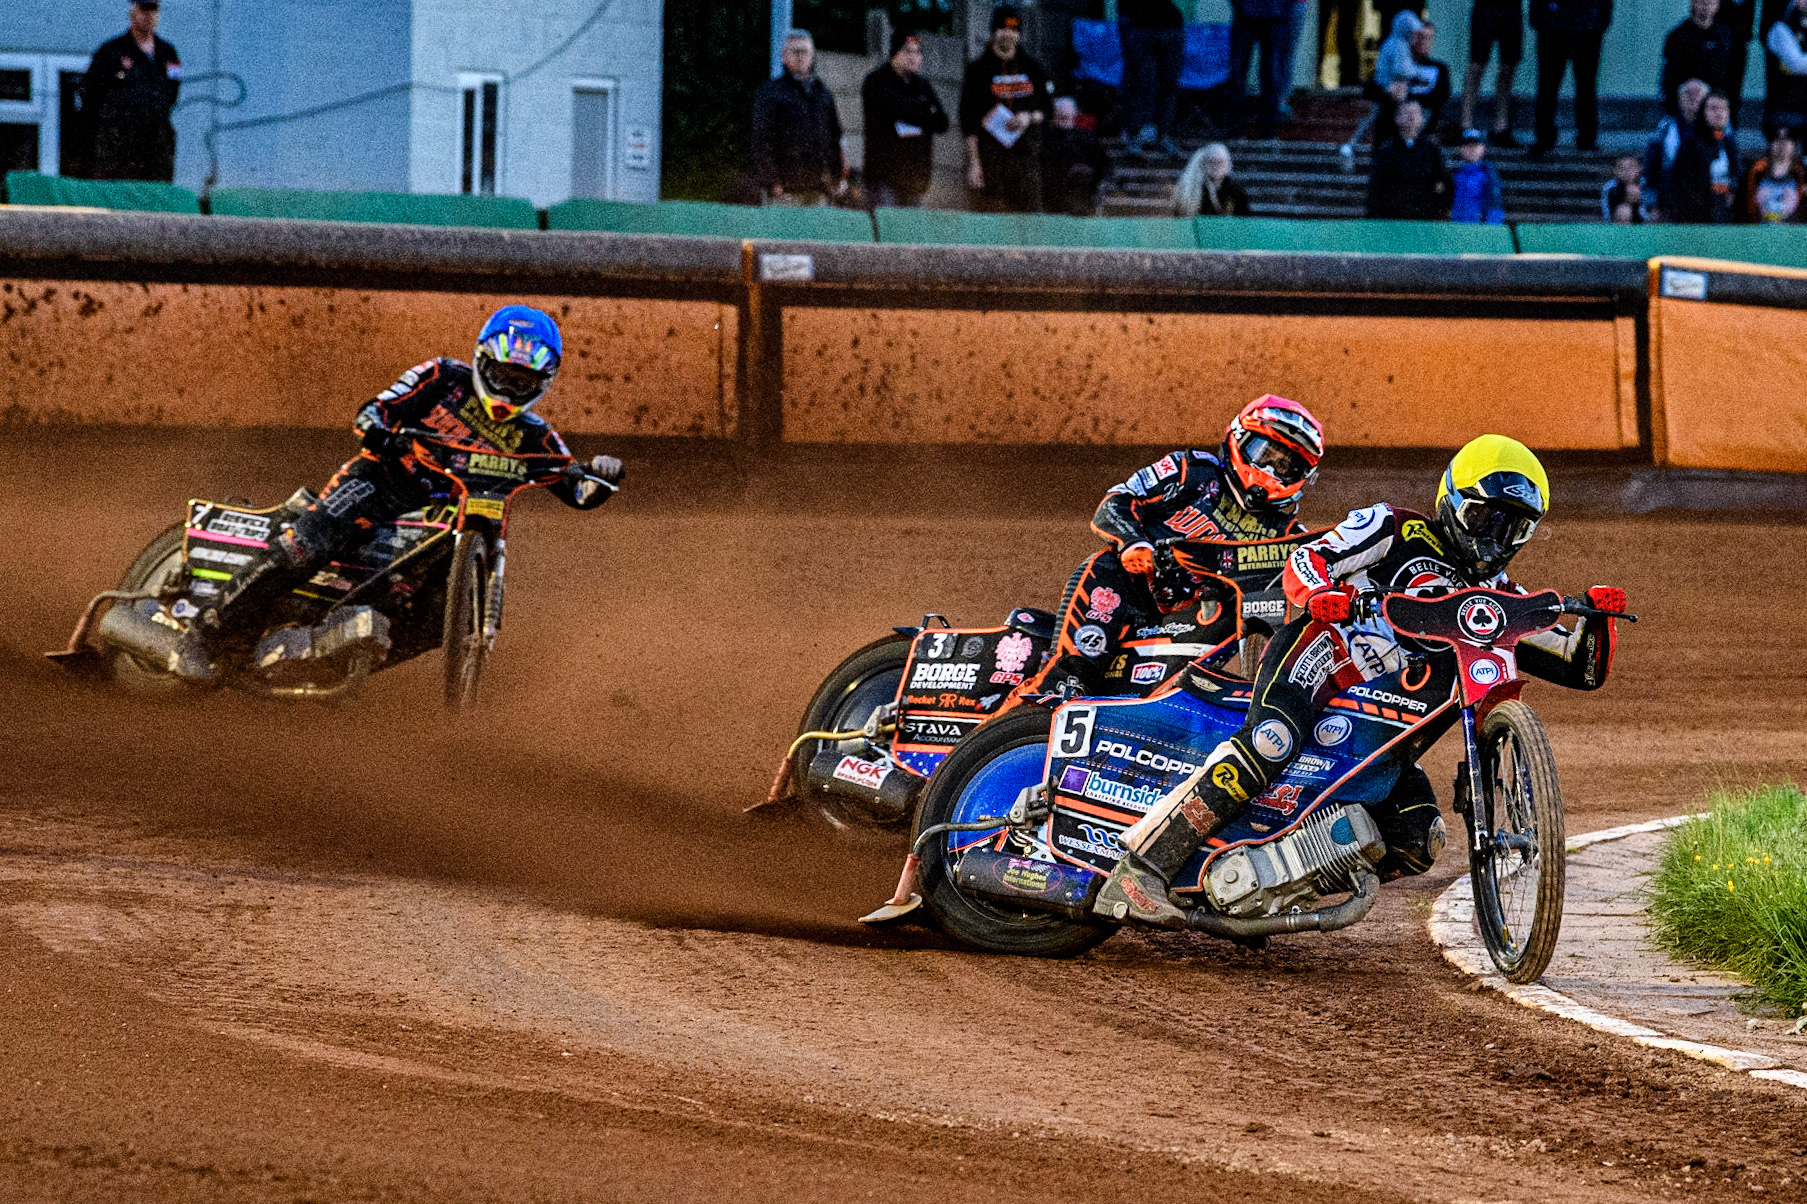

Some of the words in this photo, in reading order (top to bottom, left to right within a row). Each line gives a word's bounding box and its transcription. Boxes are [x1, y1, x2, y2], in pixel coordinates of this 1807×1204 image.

[192, 504, 209, 524] 7
[1237, 543, 1299, 563] PARRYS
[1408, 561, 1440, 575] BELLE
[1242, 600, 1286, 614] BORGE
[927, 633, 948, 658] 3
[912, 663, 981, 682] BORGE
[990, 671, 1024, 685] GPS
[1476, 667, 1494, 677] ATPI
[910, 681, 976, 690] DEVELOPMENT
[1347, 686, 1428, 713] POLCOPPER
[905, 722, 962, 736] STAVA
[1060, 710, 1090, 754] 5
[1321, 724, 1344, 735] ATPI
[1261, 728, 1286, 752] ATPI
[841, 758, 887, 780] NGK
